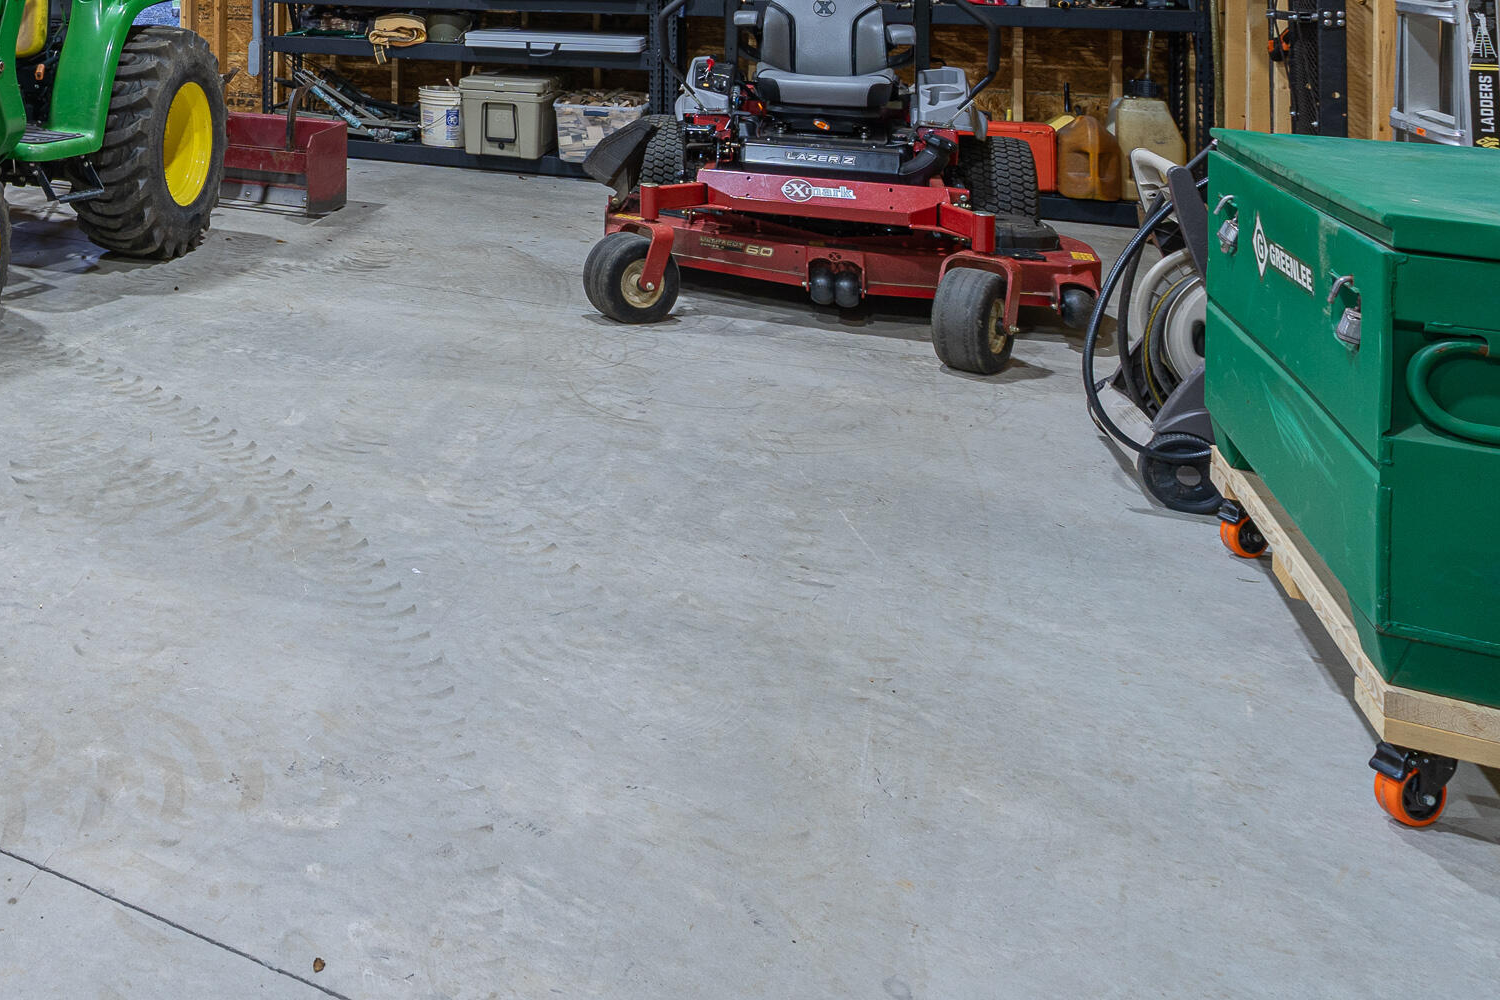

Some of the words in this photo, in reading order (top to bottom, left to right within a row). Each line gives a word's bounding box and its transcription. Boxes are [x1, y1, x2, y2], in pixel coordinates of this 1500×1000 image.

[1479, 74, 1495, 134] LADDERS
[785, 151, 840, 164] LAZER
[841, 155, 857, 165] Z
[745, 244, 774, 257] 60
[1256, 232, 1265, 260] G
[1268, 243, 1314, 293] GREENLEE
